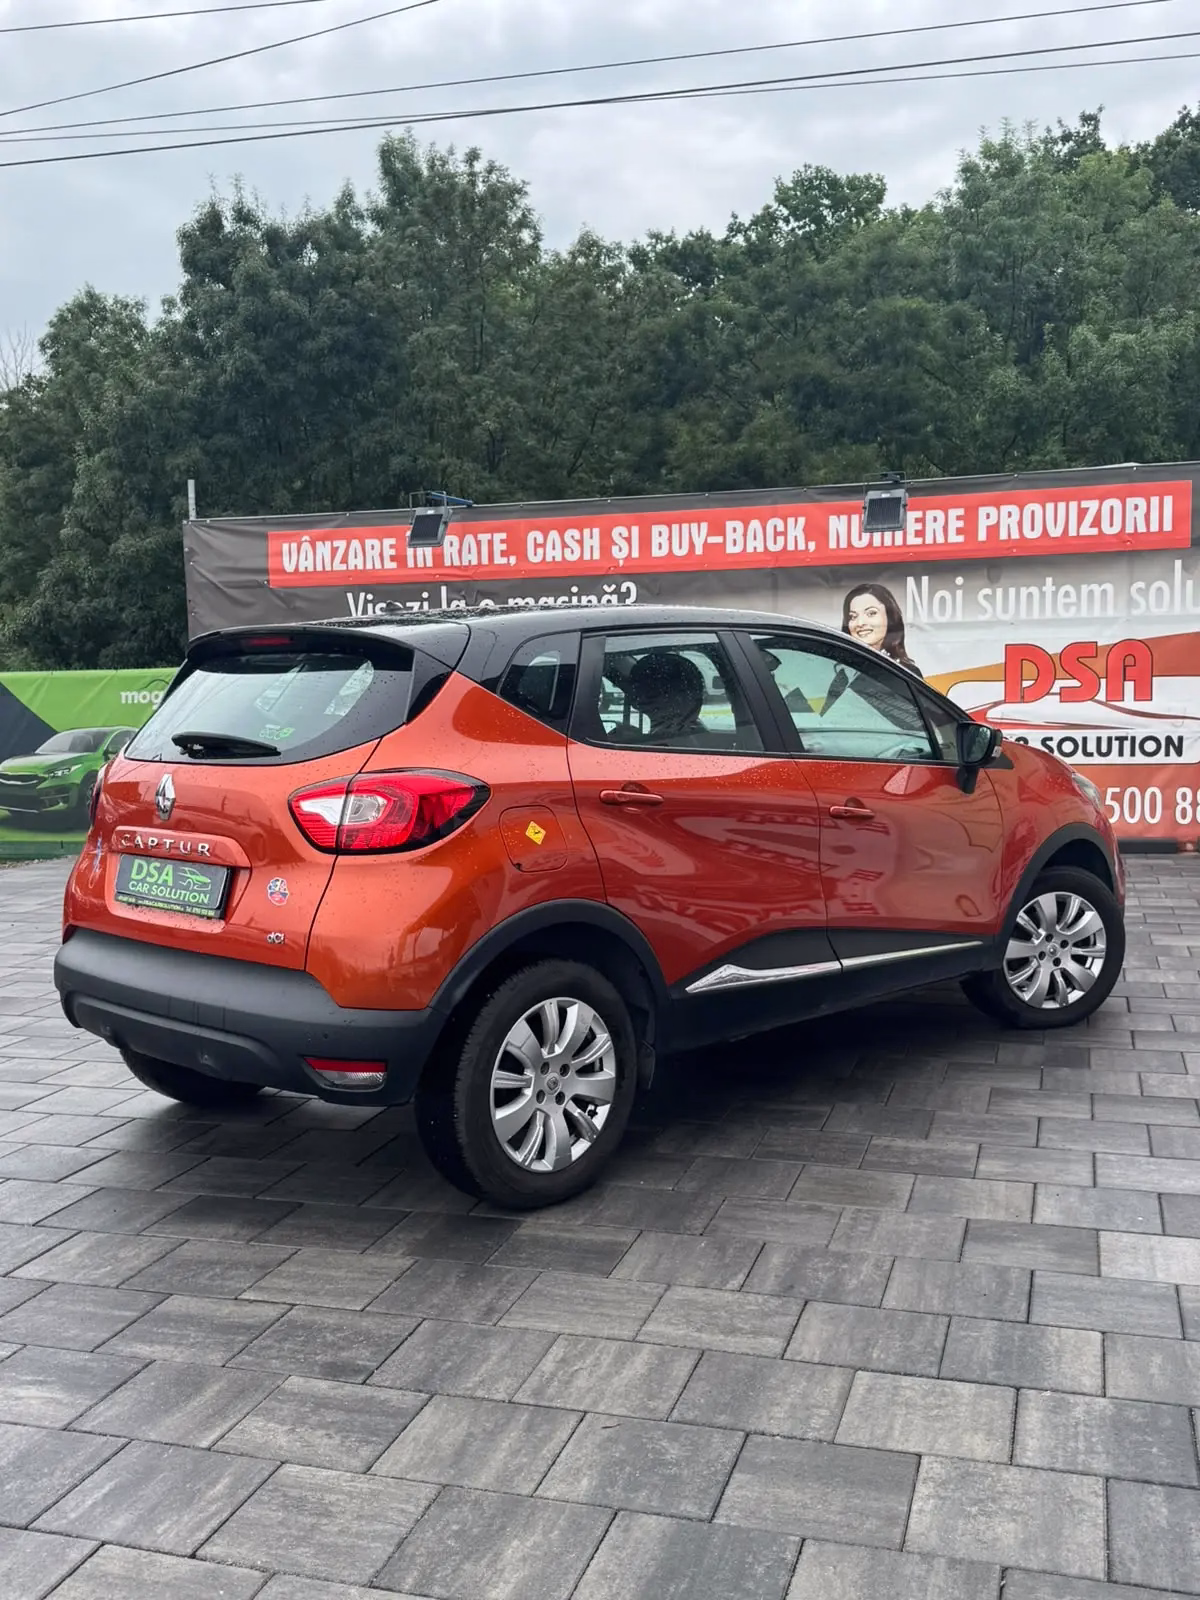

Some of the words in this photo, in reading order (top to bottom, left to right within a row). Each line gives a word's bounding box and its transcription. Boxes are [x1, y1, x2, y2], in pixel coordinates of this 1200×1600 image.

[282, 536, 397, 573] VÂNZARE
[444, 532, 516, 567] RATE,
[526, 528, 600, 563] CASH
[611, 525, 639, 567] ȘI
[651, 516, 816, 557] BUY-BACK,
[977, 495, 1173, 542] PROVIZORII
[905, 576, 963, 622] Noi
[977, 576, 1114, 623] suntem
[1004, 638, 1154, 703] DSA
[1041, 735, 1184, 758] SOLUTION
[1105, 786, 1163, 824] 500
[1175, 786, 1200, 825] 8
[120, 834, 211, 857] CAPTUR
[130, 859, 174, 886] DSA
[128, 881, 150, 894] CAR
[151, 885, 209, 904] SOLUTION
